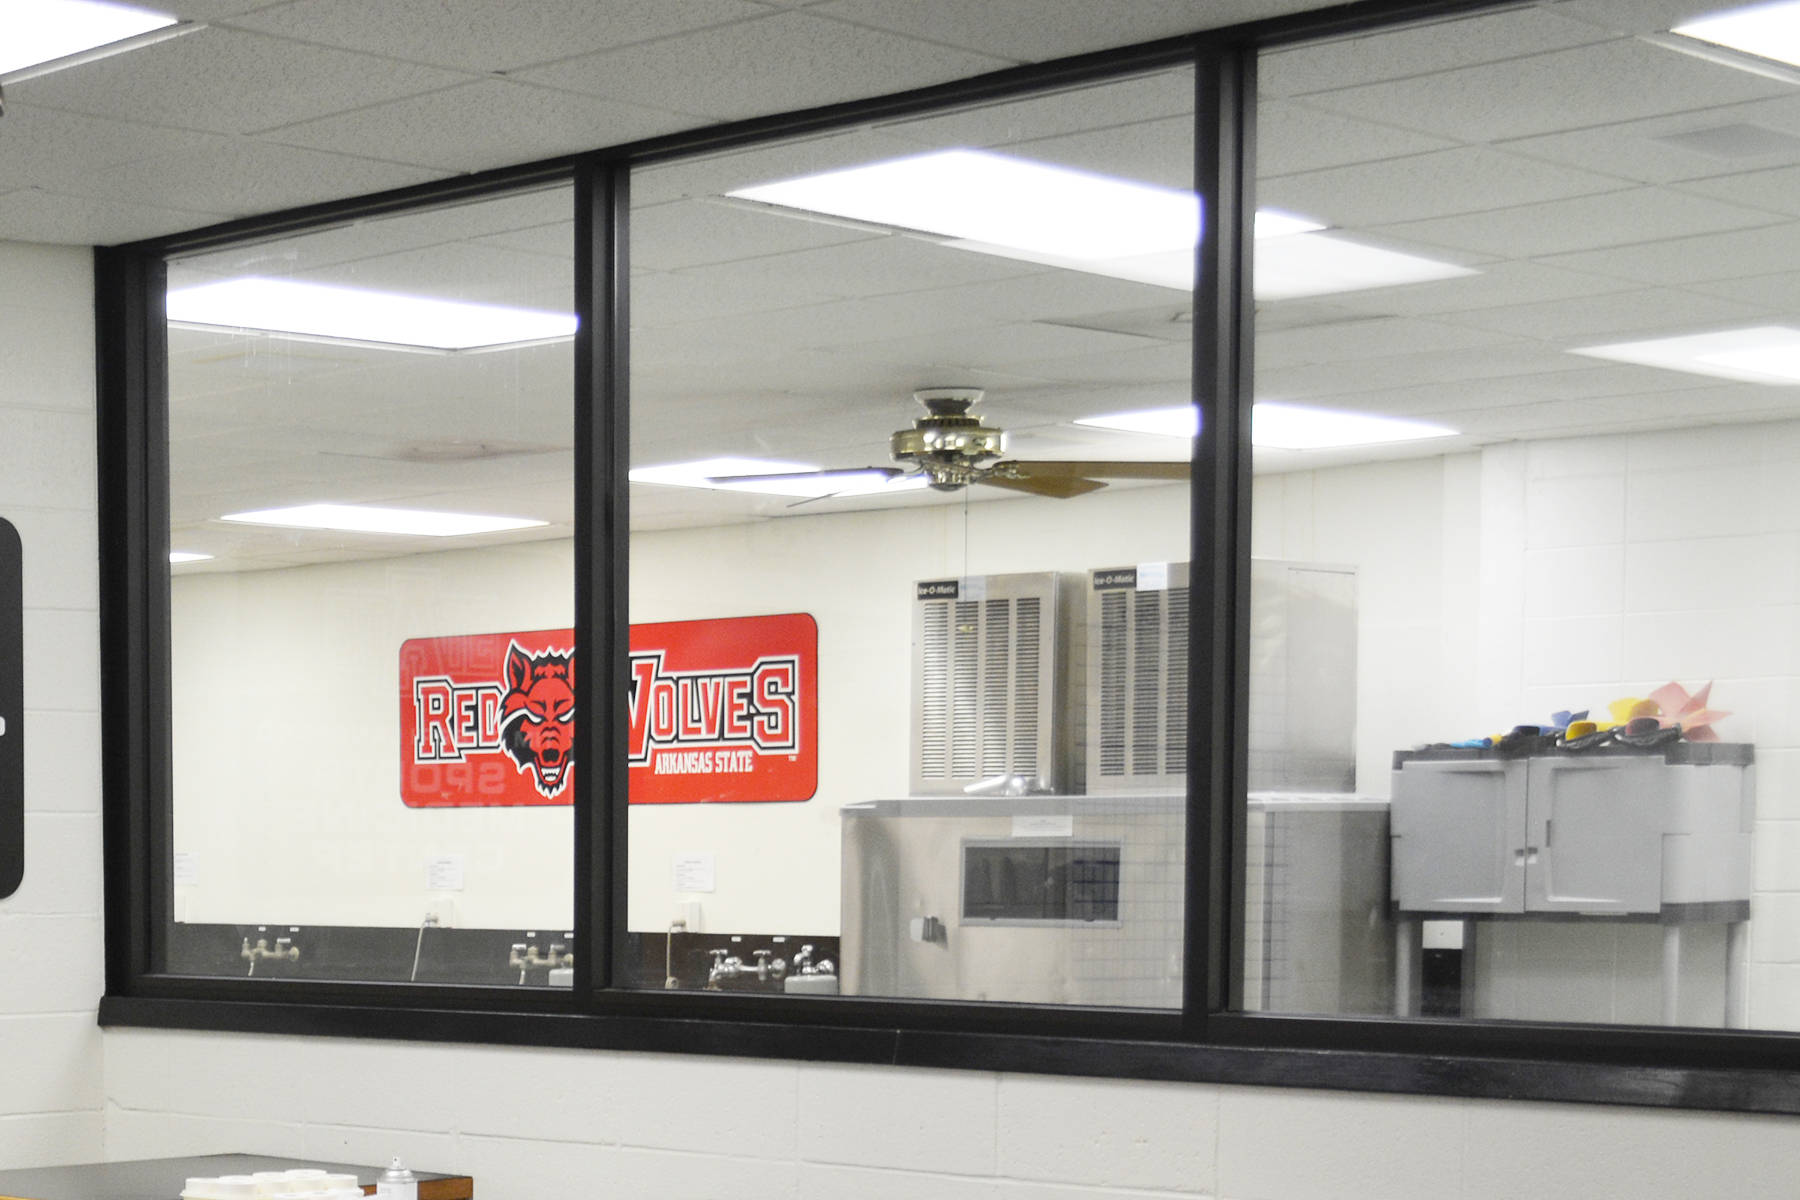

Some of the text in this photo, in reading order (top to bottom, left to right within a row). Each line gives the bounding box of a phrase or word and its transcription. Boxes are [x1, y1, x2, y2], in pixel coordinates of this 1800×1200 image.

[414, 675, 505, 765] RED
[654, 750, 754, 775] ARKANSAS STATE
